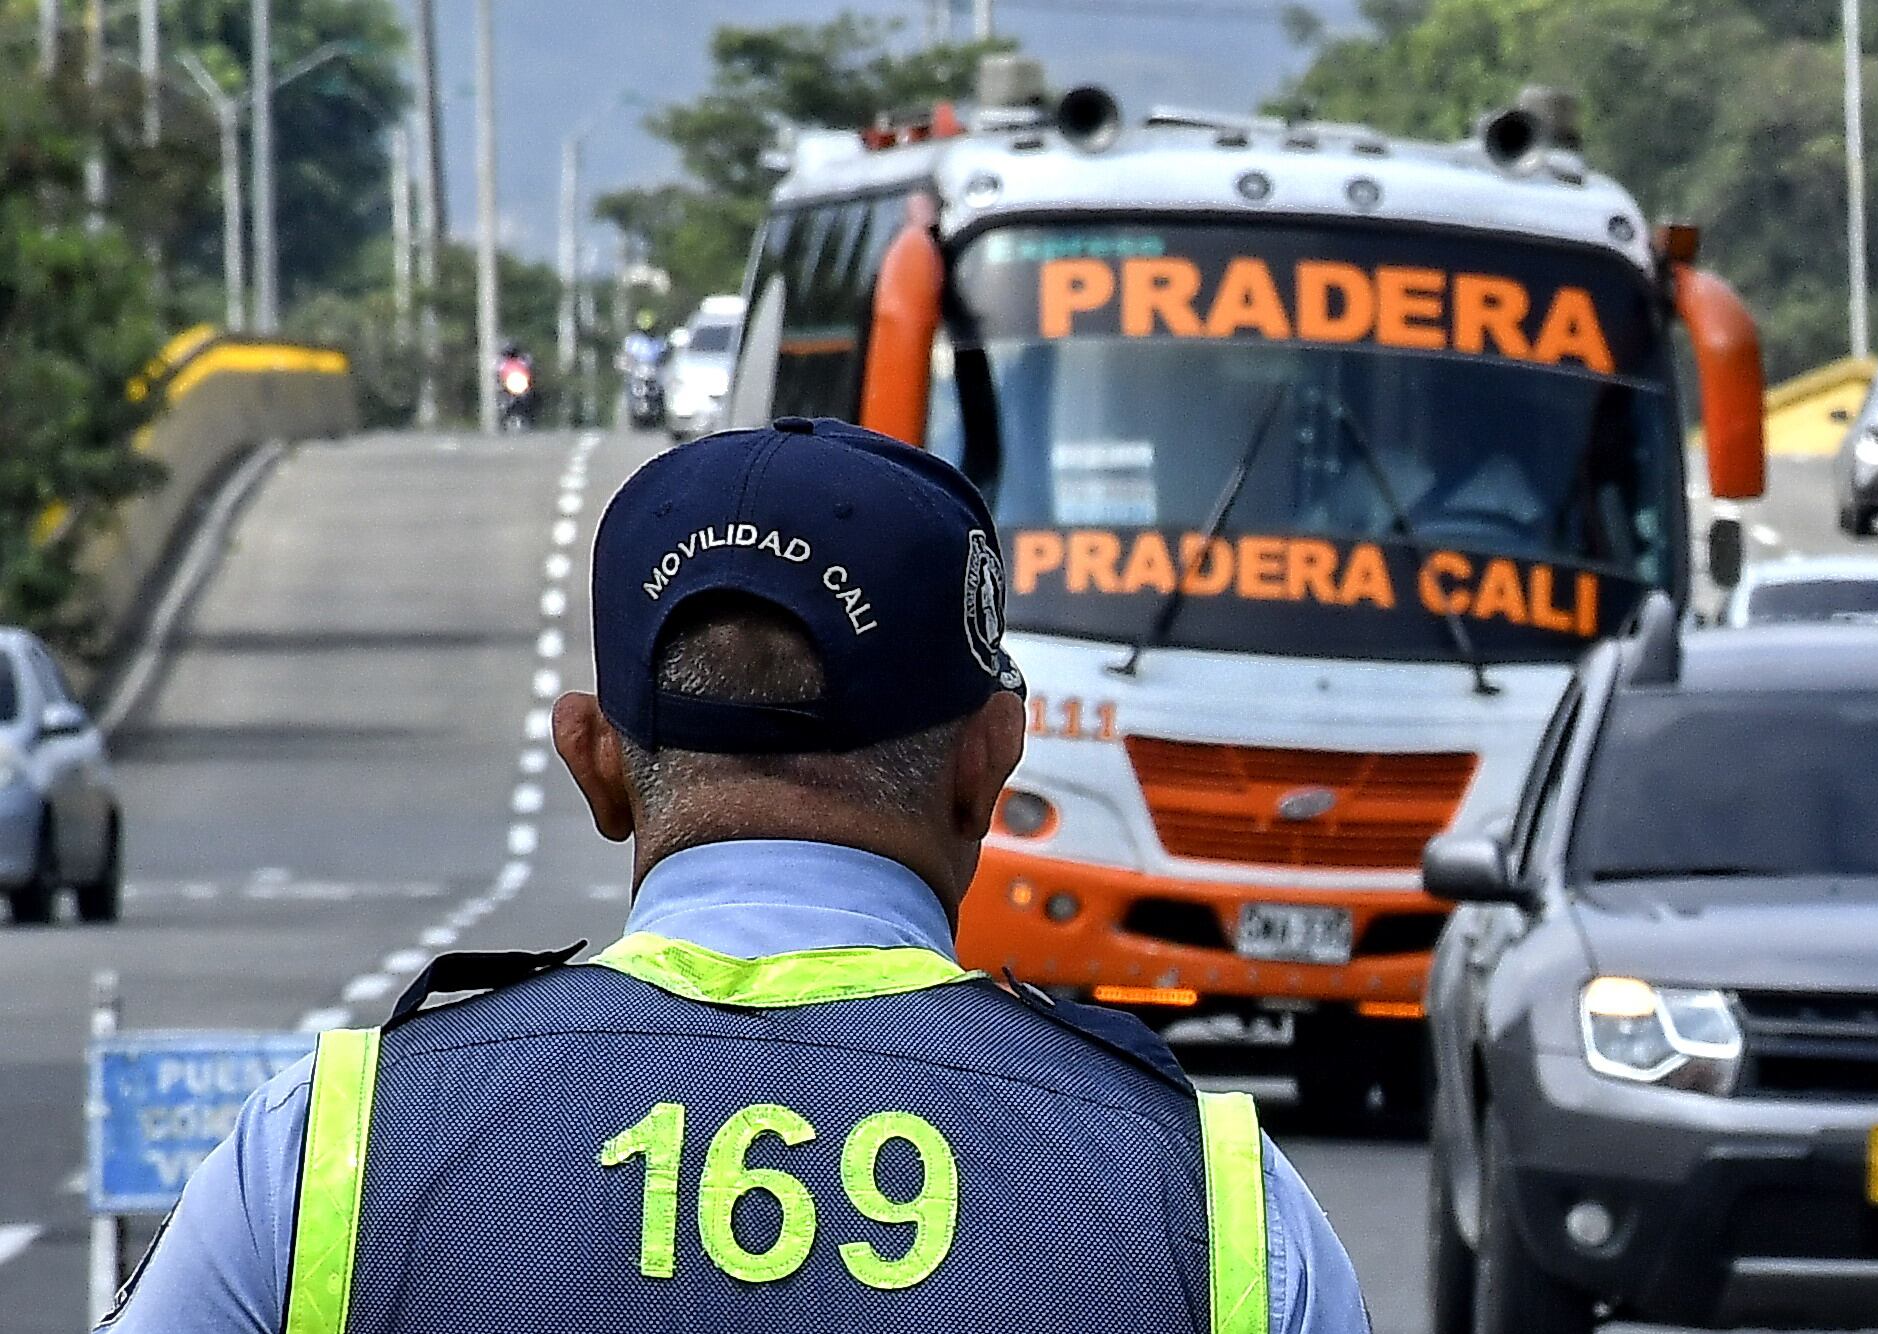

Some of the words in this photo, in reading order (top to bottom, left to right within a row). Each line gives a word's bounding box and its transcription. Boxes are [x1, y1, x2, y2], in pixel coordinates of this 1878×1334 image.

[1040, 256, 1614, 375] PRADERA
[643, 523, 811, 600] MOVILIDAD
[823, 565, 877, 636] CALI
[1014, 529, 1395, 609] PRADERA
[1420, 551, 1598, 637] CALI
[600, 1102, 958, 1290] 169
